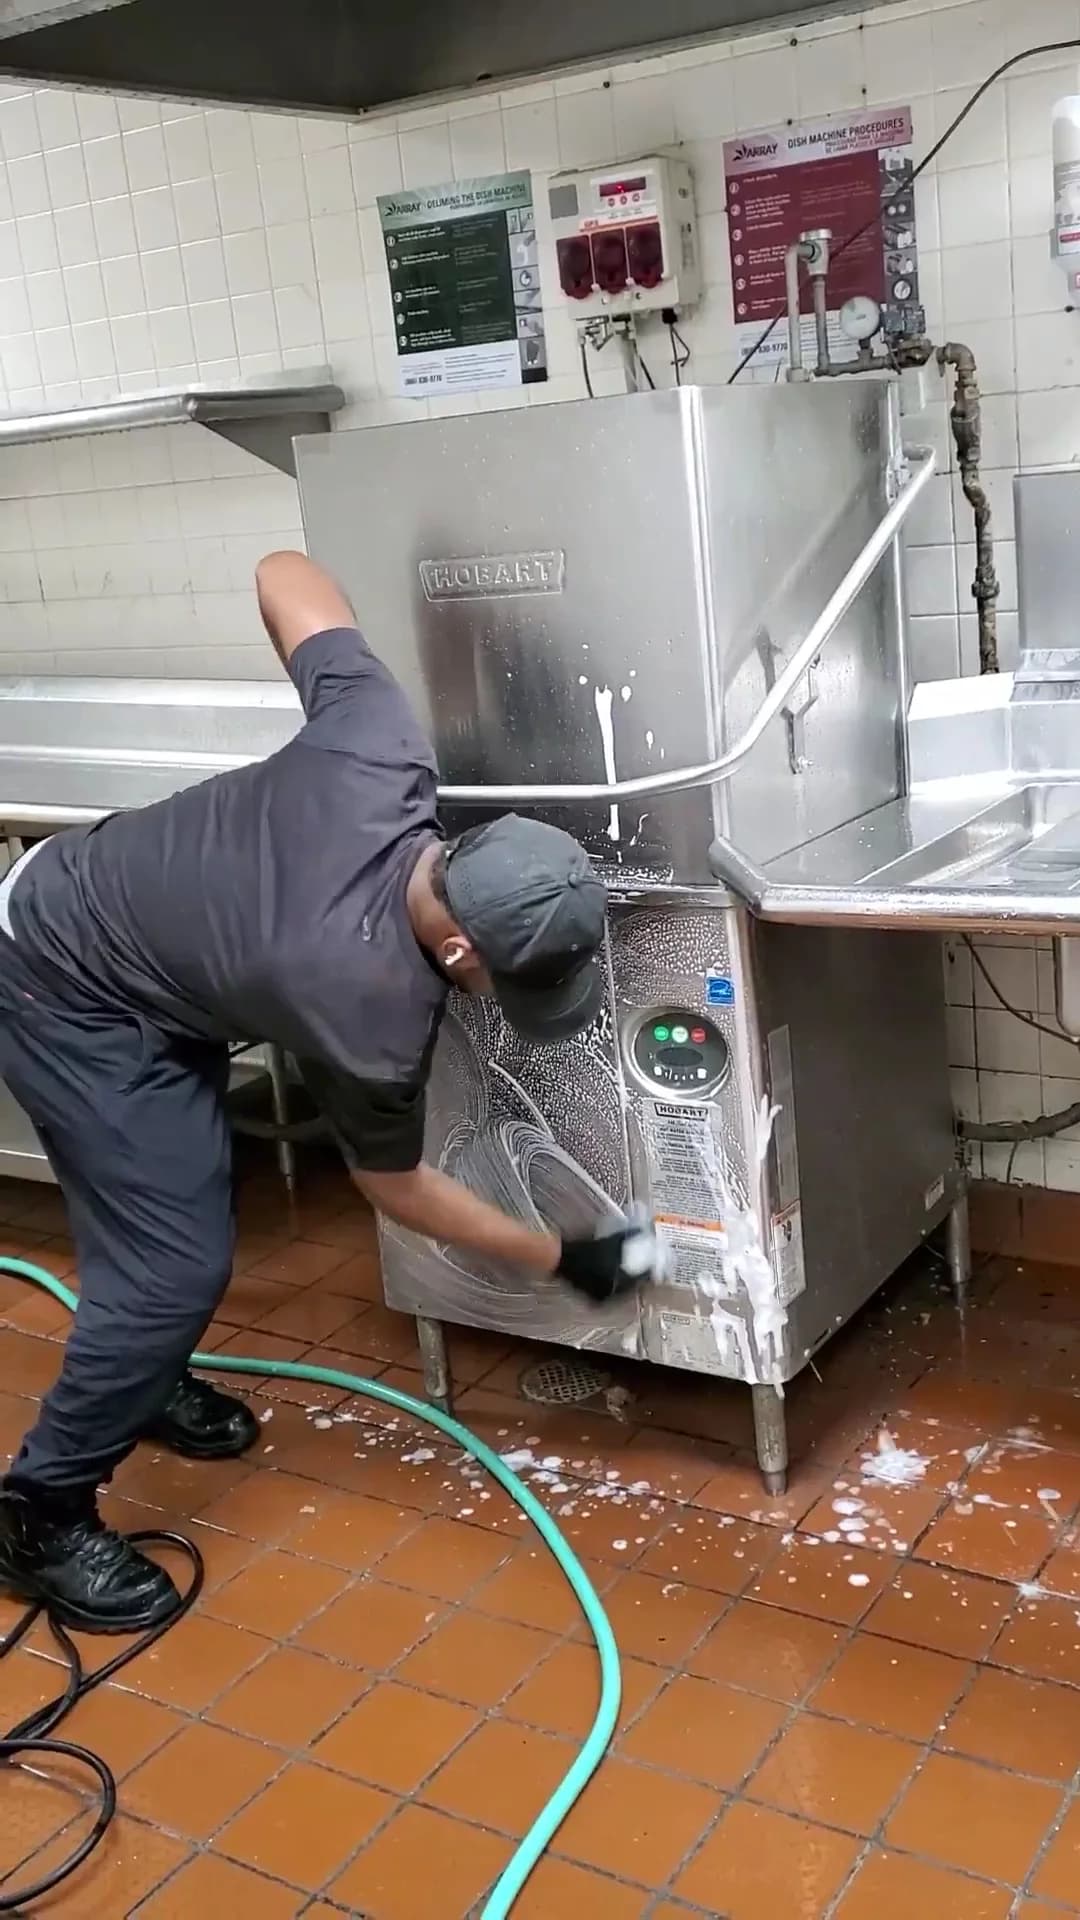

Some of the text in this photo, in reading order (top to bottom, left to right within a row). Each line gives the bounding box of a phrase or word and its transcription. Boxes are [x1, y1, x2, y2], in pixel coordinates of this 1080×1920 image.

[787, 136, 807, 149] DISH
[809, 128, 847, 145] MACHINE
[849, 117, 904, 136] PROCEDURES
[746, 143, 778, 159] ARRAY
[426, 195, 460, 209] DELIMING
[461, 192, 475, 203] THE
[475, 188, 493, 200] DISH
[494, 183, 526, 196] MACHINE
[396, 202, 421, 215] ARRAY
[430, 561, 552, 589] HOBART
[660, 1105, 704, 1117] HOBART
